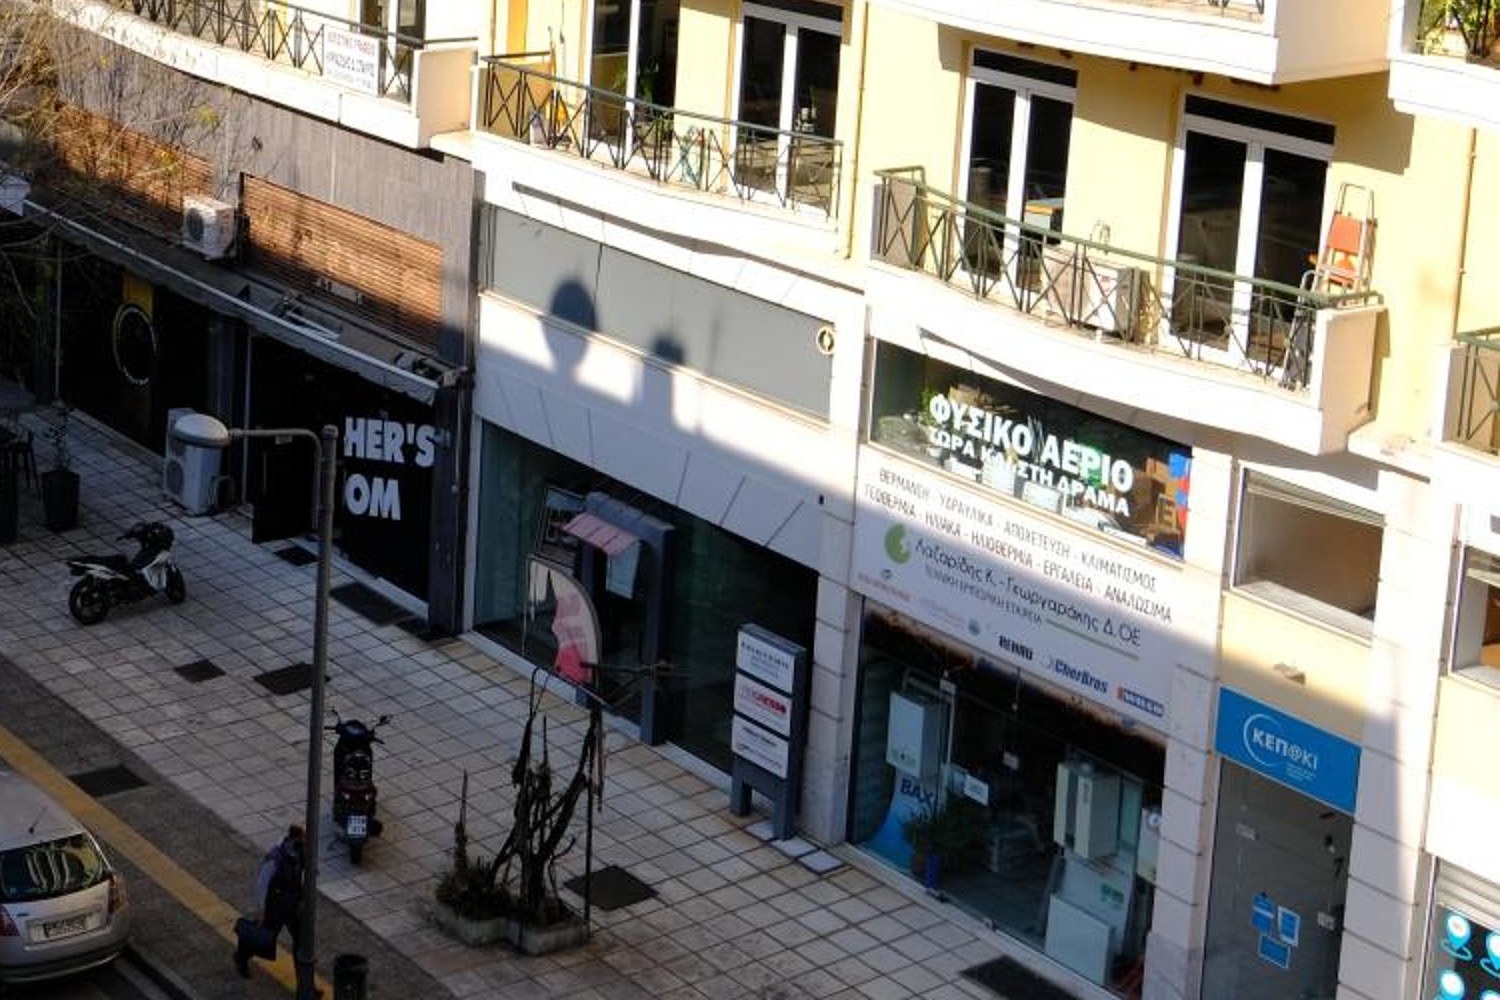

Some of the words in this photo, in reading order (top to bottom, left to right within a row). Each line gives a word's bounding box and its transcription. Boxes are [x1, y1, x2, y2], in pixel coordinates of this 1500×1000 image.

[929, 394, 1033, 455] ΦΥΣΙΚΟ
[1039, 434, 1134, 494] ΑΕΡΙΟ
[1057, 474, 1131, 518] ΔΡΑΜΑ
